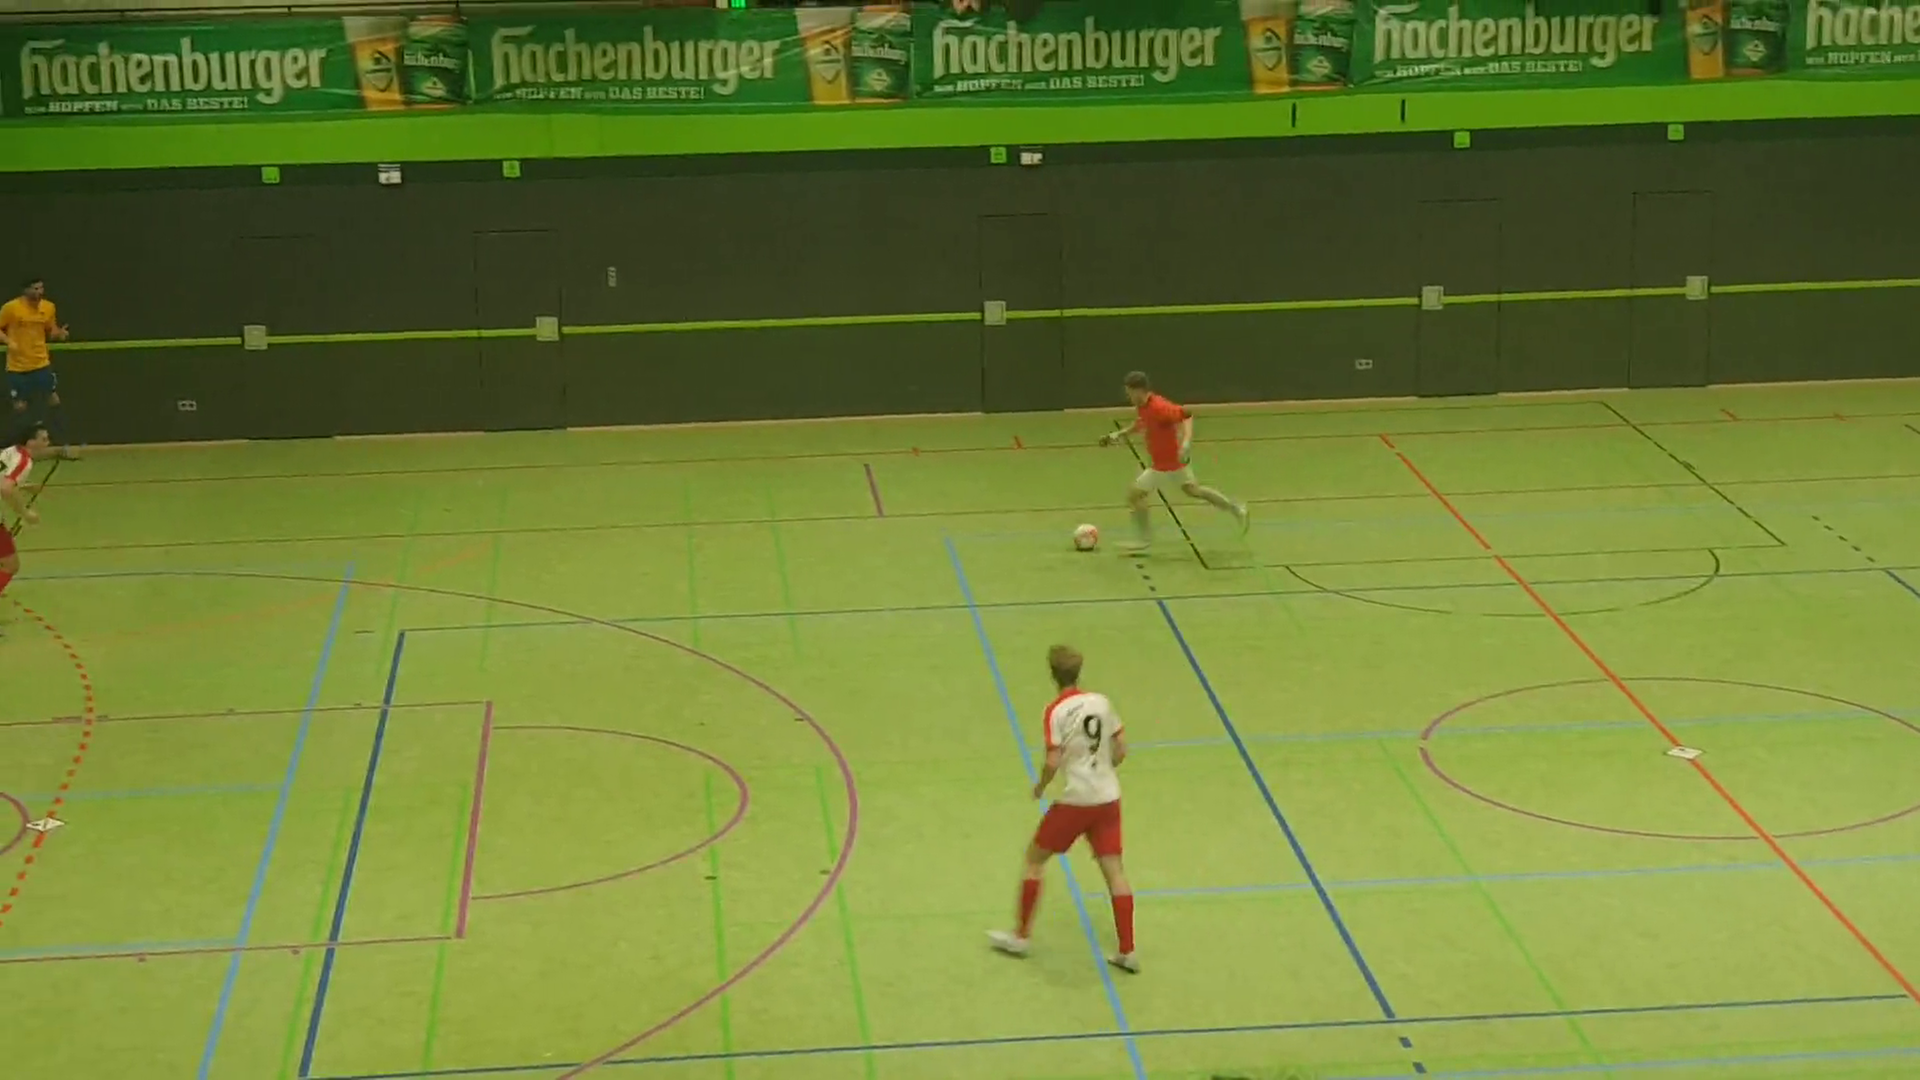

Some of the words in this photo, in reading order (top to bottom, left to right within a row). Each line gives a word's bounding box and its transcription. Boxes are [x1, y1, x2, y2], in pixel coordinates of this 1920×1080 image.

[1488, 61, 1521, 74] DAS
[1050, 77, 1084, 90] DAS
[1086, 74, 1144, 88] BESTE!
[609, 87, 644, 100] DAS
[646, 86, 704, 100] BESTE!
[147, 98, 183, 111] DAS
[186, 96, 248, 110] BESTE!
[1083, 715, 1102, 755] 9
